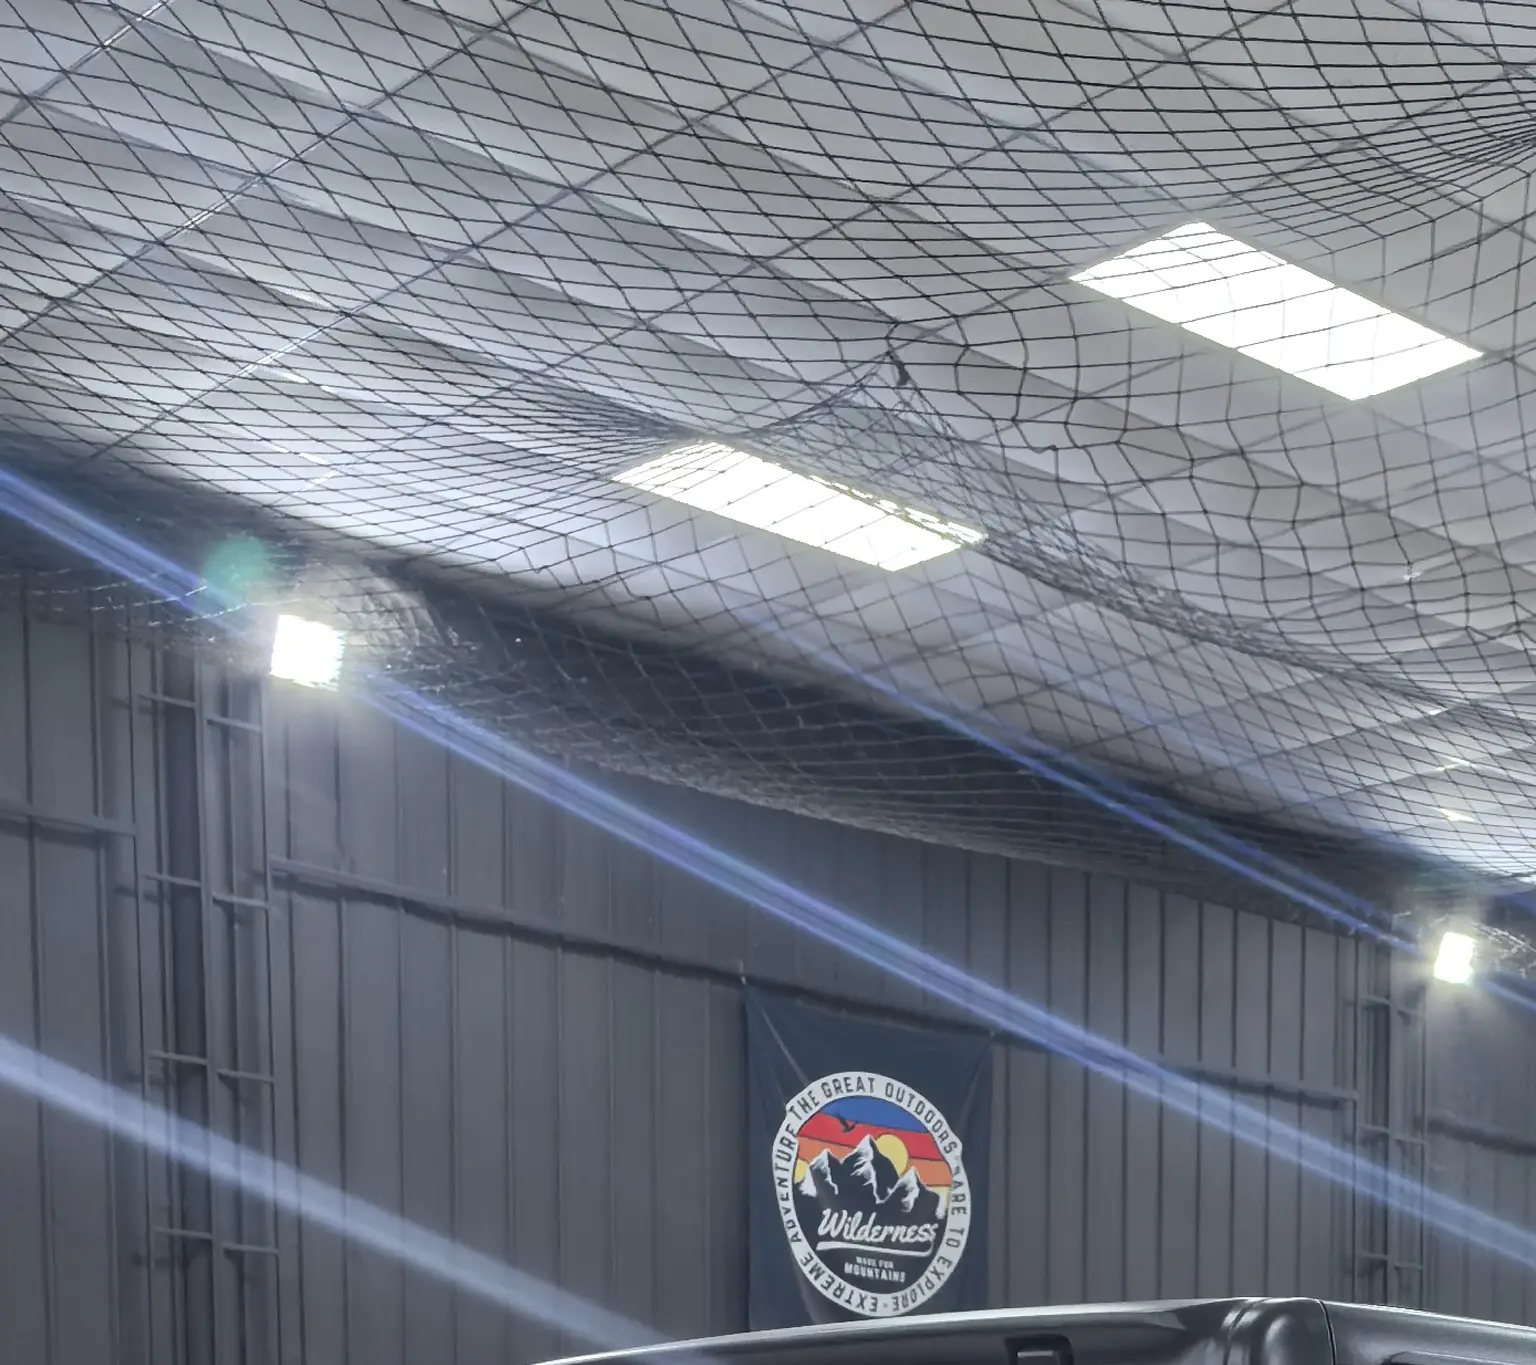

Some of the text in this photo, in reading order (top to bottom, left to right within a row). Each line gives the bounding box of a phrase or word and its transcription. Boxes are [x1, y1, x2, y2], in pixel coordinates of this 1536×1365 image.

[788, 1076, 958, 1155] THE GREAT OUTDOORS
[775, 1123, 879, 1313] EXTREME ADVENTURE
[817, 1207, 939, 1243] Wilderness
[945, 1227, 966, 1249] TO
[843, 1261, 906, 1283] MOUNTAINS
[890, 1255, 954, 1313] EXPLORE
